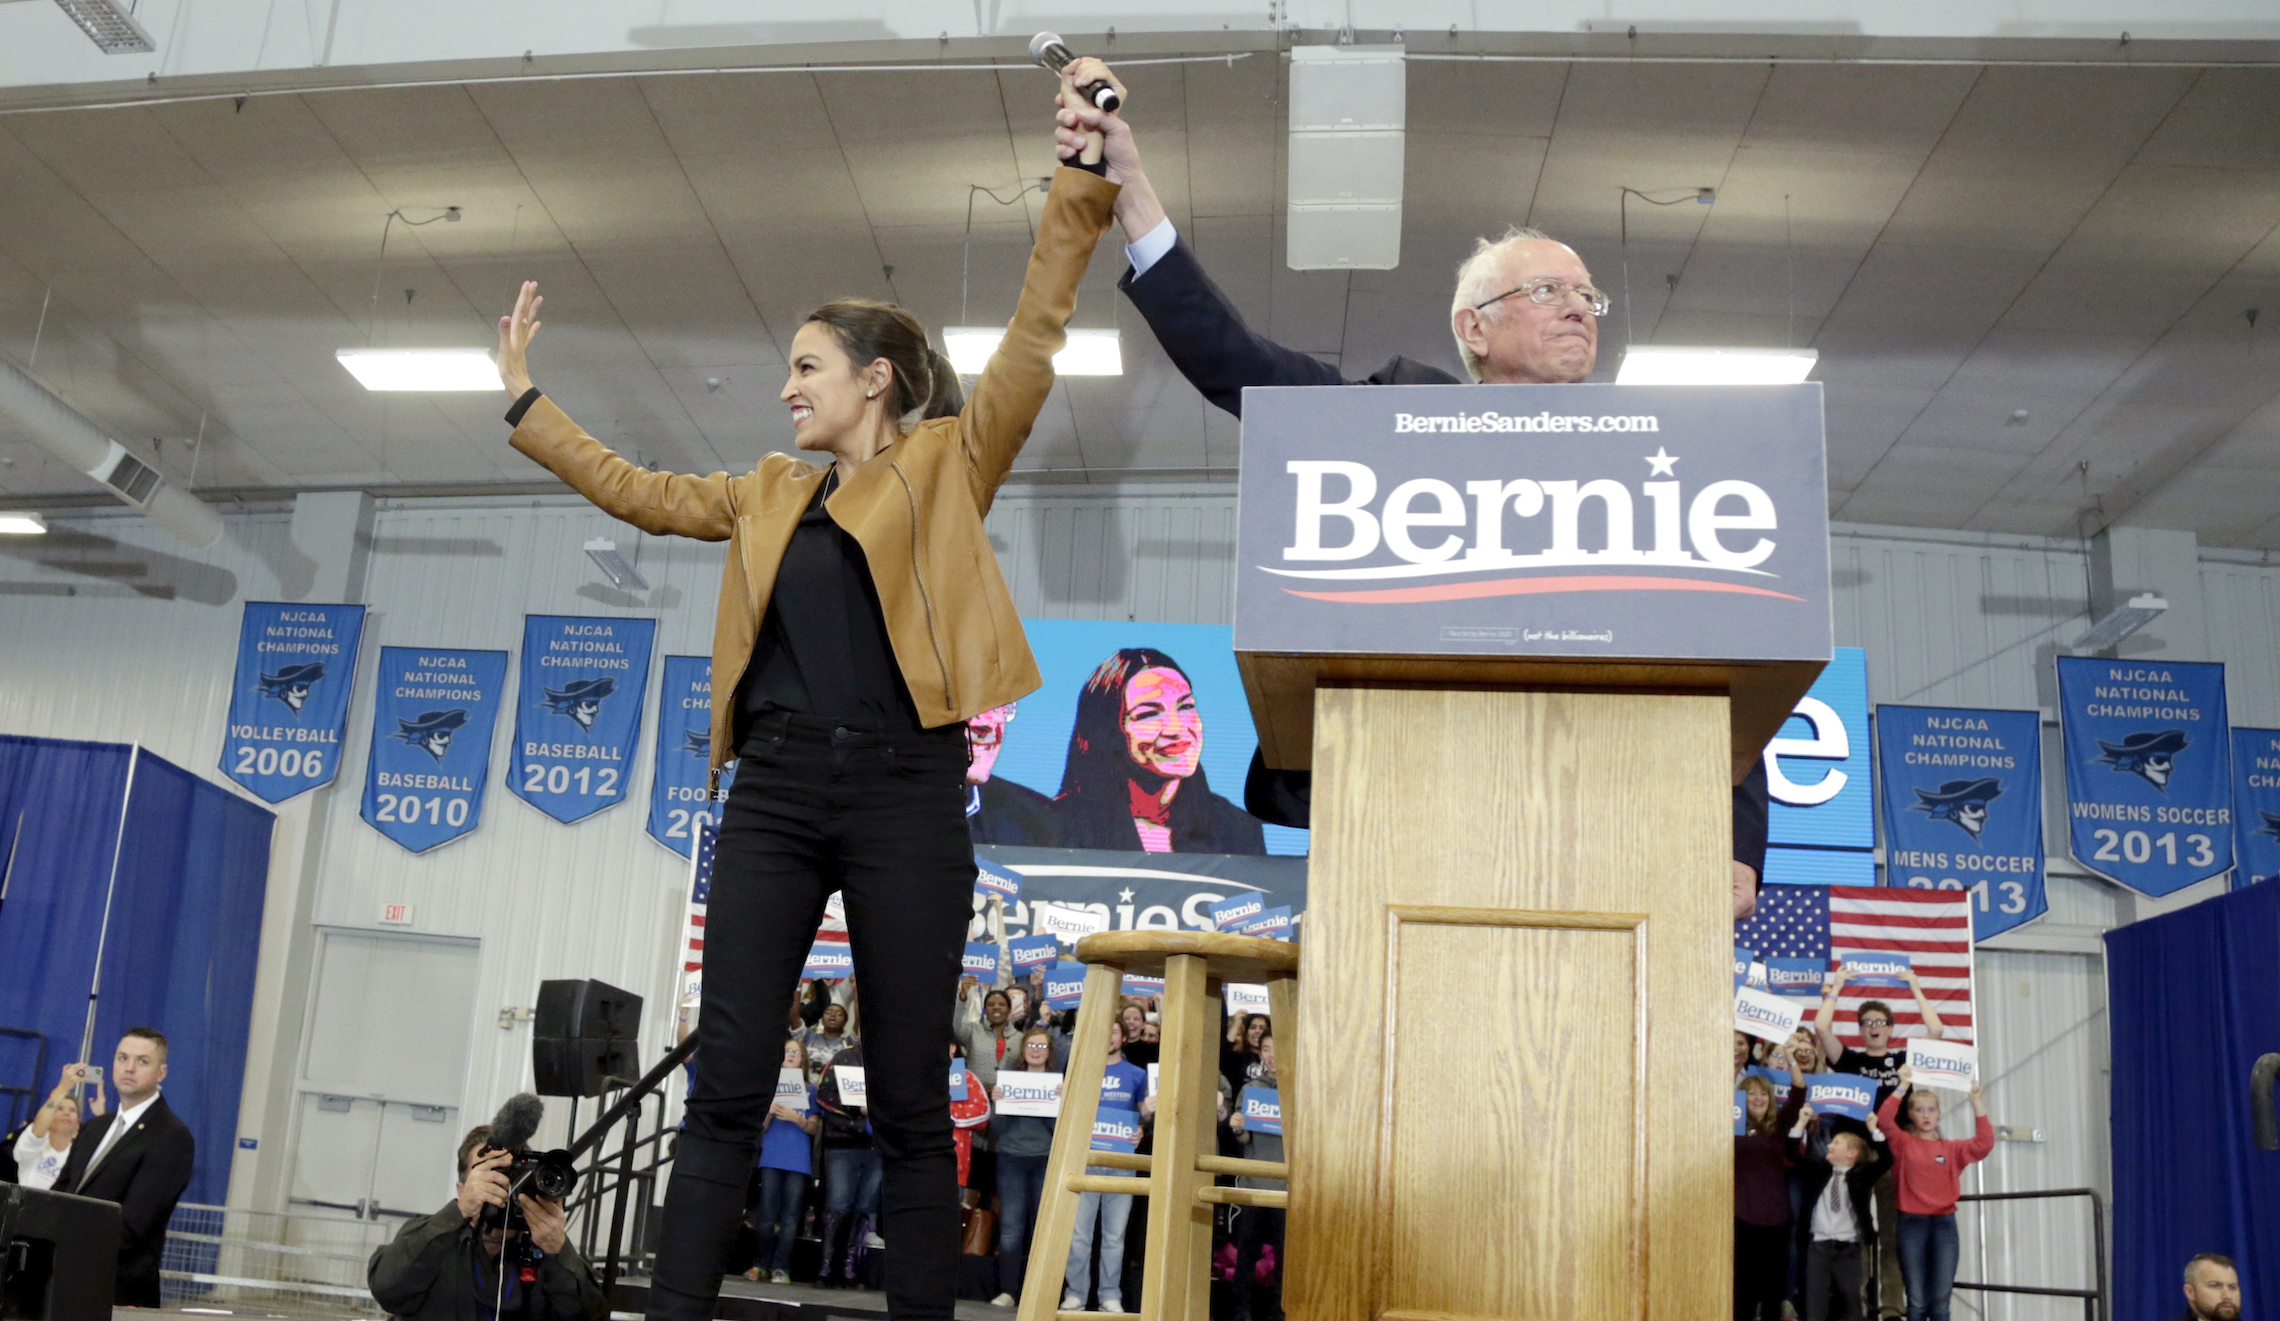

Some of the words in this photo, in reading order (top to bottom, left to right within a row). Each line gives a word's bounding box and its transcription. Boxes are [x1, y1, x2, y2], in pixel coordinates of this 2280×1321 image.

[1395, 411, 1659, 433] BernieSanders.com
[1282, 446, 1778, 569] Bernie
[280, 611, 327, 623] NJCAA
[266, 626, 335, 639] NATIONAL
[563, 625, 613, 637] NJCAA
[257, 641, 339, 655] CHAMPIONS
[549, 639, 624, 654] NATIONAL
[418, 656, 467, 669] NJCAA
[541, 655, 630, 669] CHAMPIONS
[404, 671, 477, 686] NATIONAL
[2109, 668, 2173, 683] NJCAA
[395, 687, 482, 702] CHAMPIONS
[2094, 686, 2190, 703] NATIONAL
[2086, 703, 2200, 721] CHAMPIONS
[1927, 716, 1989, 731] NJCAA
[231, 724, 339, 743] VOLLEYBALL
[1913, 734, 2005, 750] NATIONAL
[524, 742, 623, 761] BASEBALL
[1904, 751, 2015, 769] CHAMPIONS
[234, 746, 323, 778] 2006
[377, 772, 473, 792] BASEBALL
[523, 763, 619, 797] 2012
[375, 794, 469, 827] 2010
[2073, 802, 2151, 823] WOMENS
[2156, 805, 2231, 826] SOCCER
[2093, 828, 2216, 867] 2013
[1894, 850, 1950, 869] MENS
[1955, 852, 2035, 873] SOCCER
[978, 868, 1019, 894] Bernie
[385, 905, 406, 921] EXIT
[1214, 902, 1262, 924] Bernie
[1047, 915, 1095, 932] Bernie
[962, 954, 995, 970] ernie
[1013, 944, 1057, 962] Bernie
[1769, 968, 1822, 984] Bernie
[1047, 977, 1085, 995] Bern
[1736, 1000, 1793, 1030] Bernie
[1912, 1052, 1972, 1075] Bernie
[1002, 1083, 1057, 1101] Bernie
[1811, 1085, 1871, 1106] Bernie
[1092, 1120, 1133, 1138] ernie
